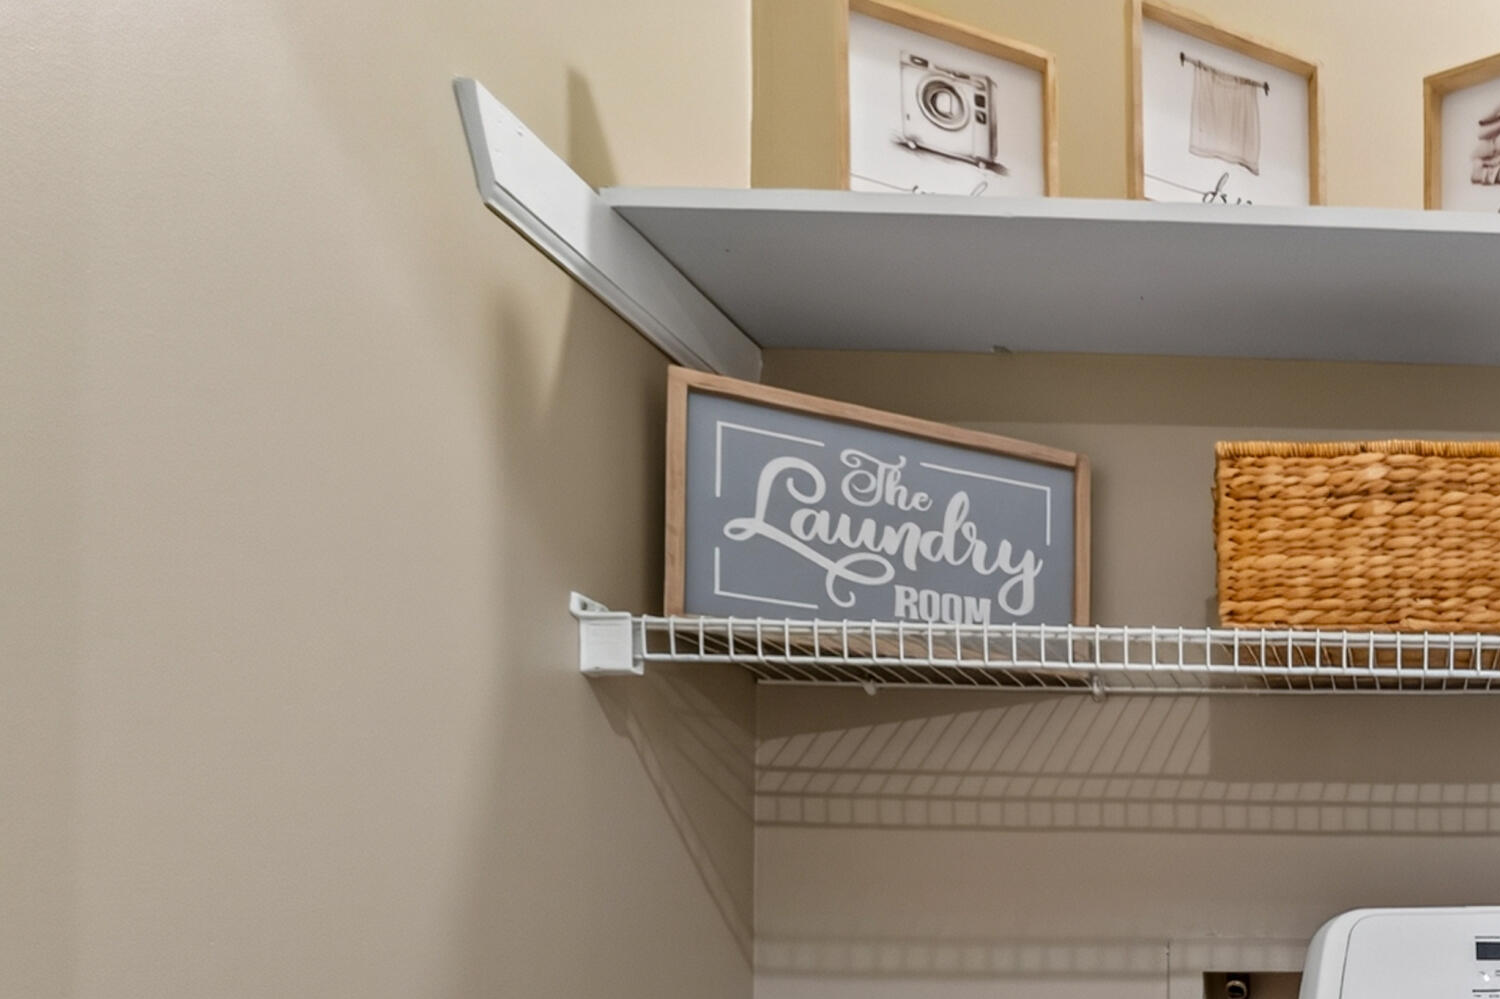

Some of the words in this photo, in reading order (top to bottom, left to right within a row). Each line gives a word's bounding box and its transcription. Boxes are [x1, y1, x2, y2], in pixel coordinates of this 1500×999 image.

[840, 448, 933, 511] The
[723, 456, 1043, 616] Laundry
[894, 584, 992, 625] ROOM
